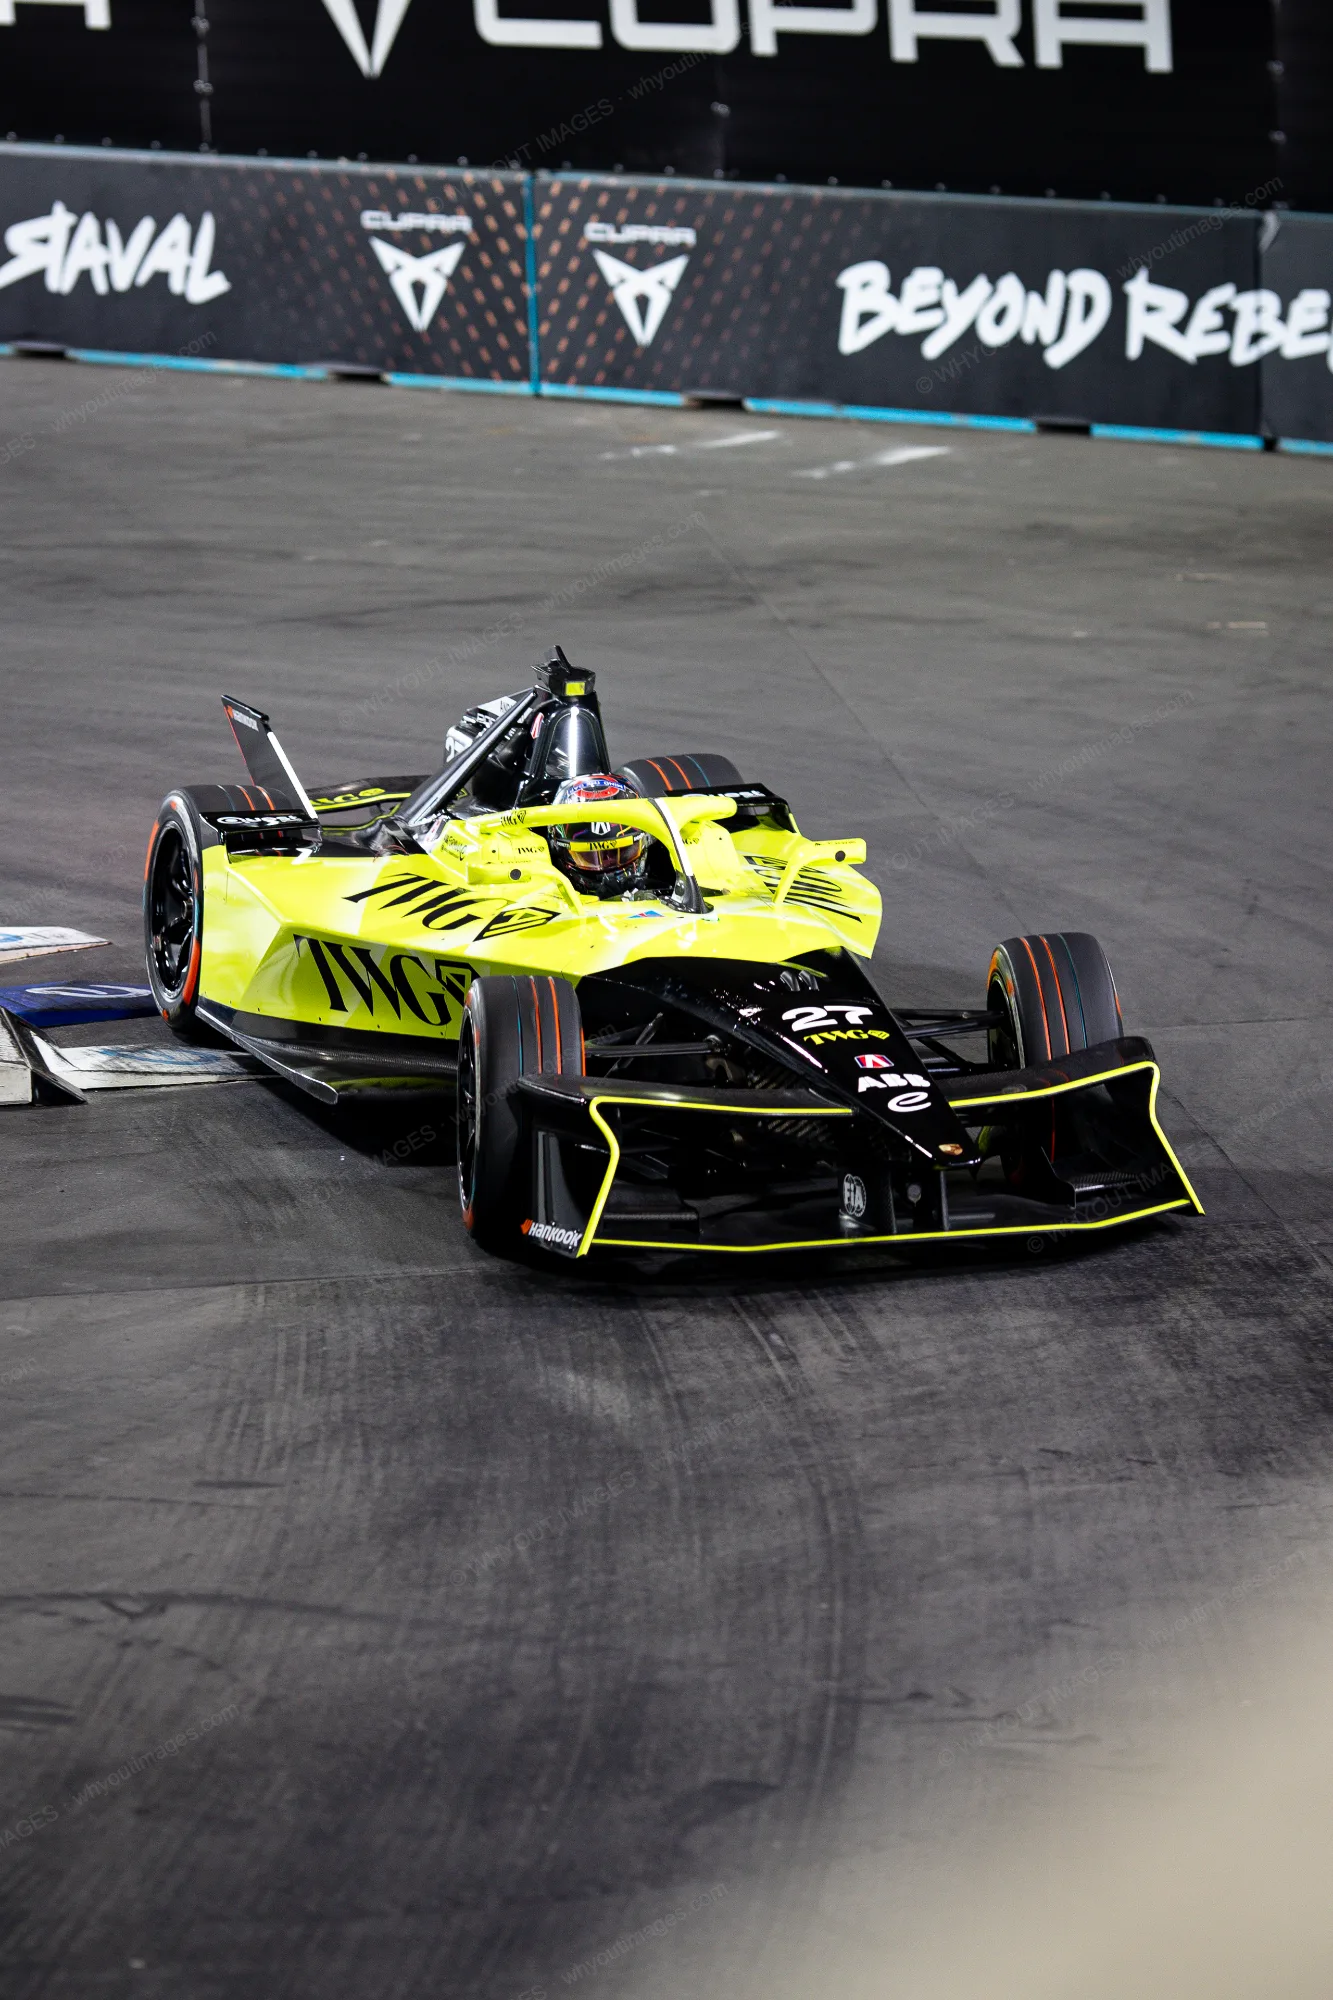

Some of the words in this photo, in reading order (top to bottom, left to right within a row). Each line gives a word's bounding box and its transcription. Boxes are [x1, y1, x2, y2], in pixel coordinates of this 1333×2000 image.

[361, 209, 472, 232] CUPRA
[584, 222, 696, 246] CUPRA
[837, 261, 1111, 369] BEYOND
[1123, 266, 1333, 374] REBE
[341, 872, 516, 931] TWG
[293, 934, 452, 1027] TWG
[782, 1005, 873, 1032] 27
[803, 1029, 869, 1046] TWG
[857, 1073, 931, 1093] ABB
[844, 1178, 865, 1210] FIA
[528, 1221, 583, 1247] Hankook
